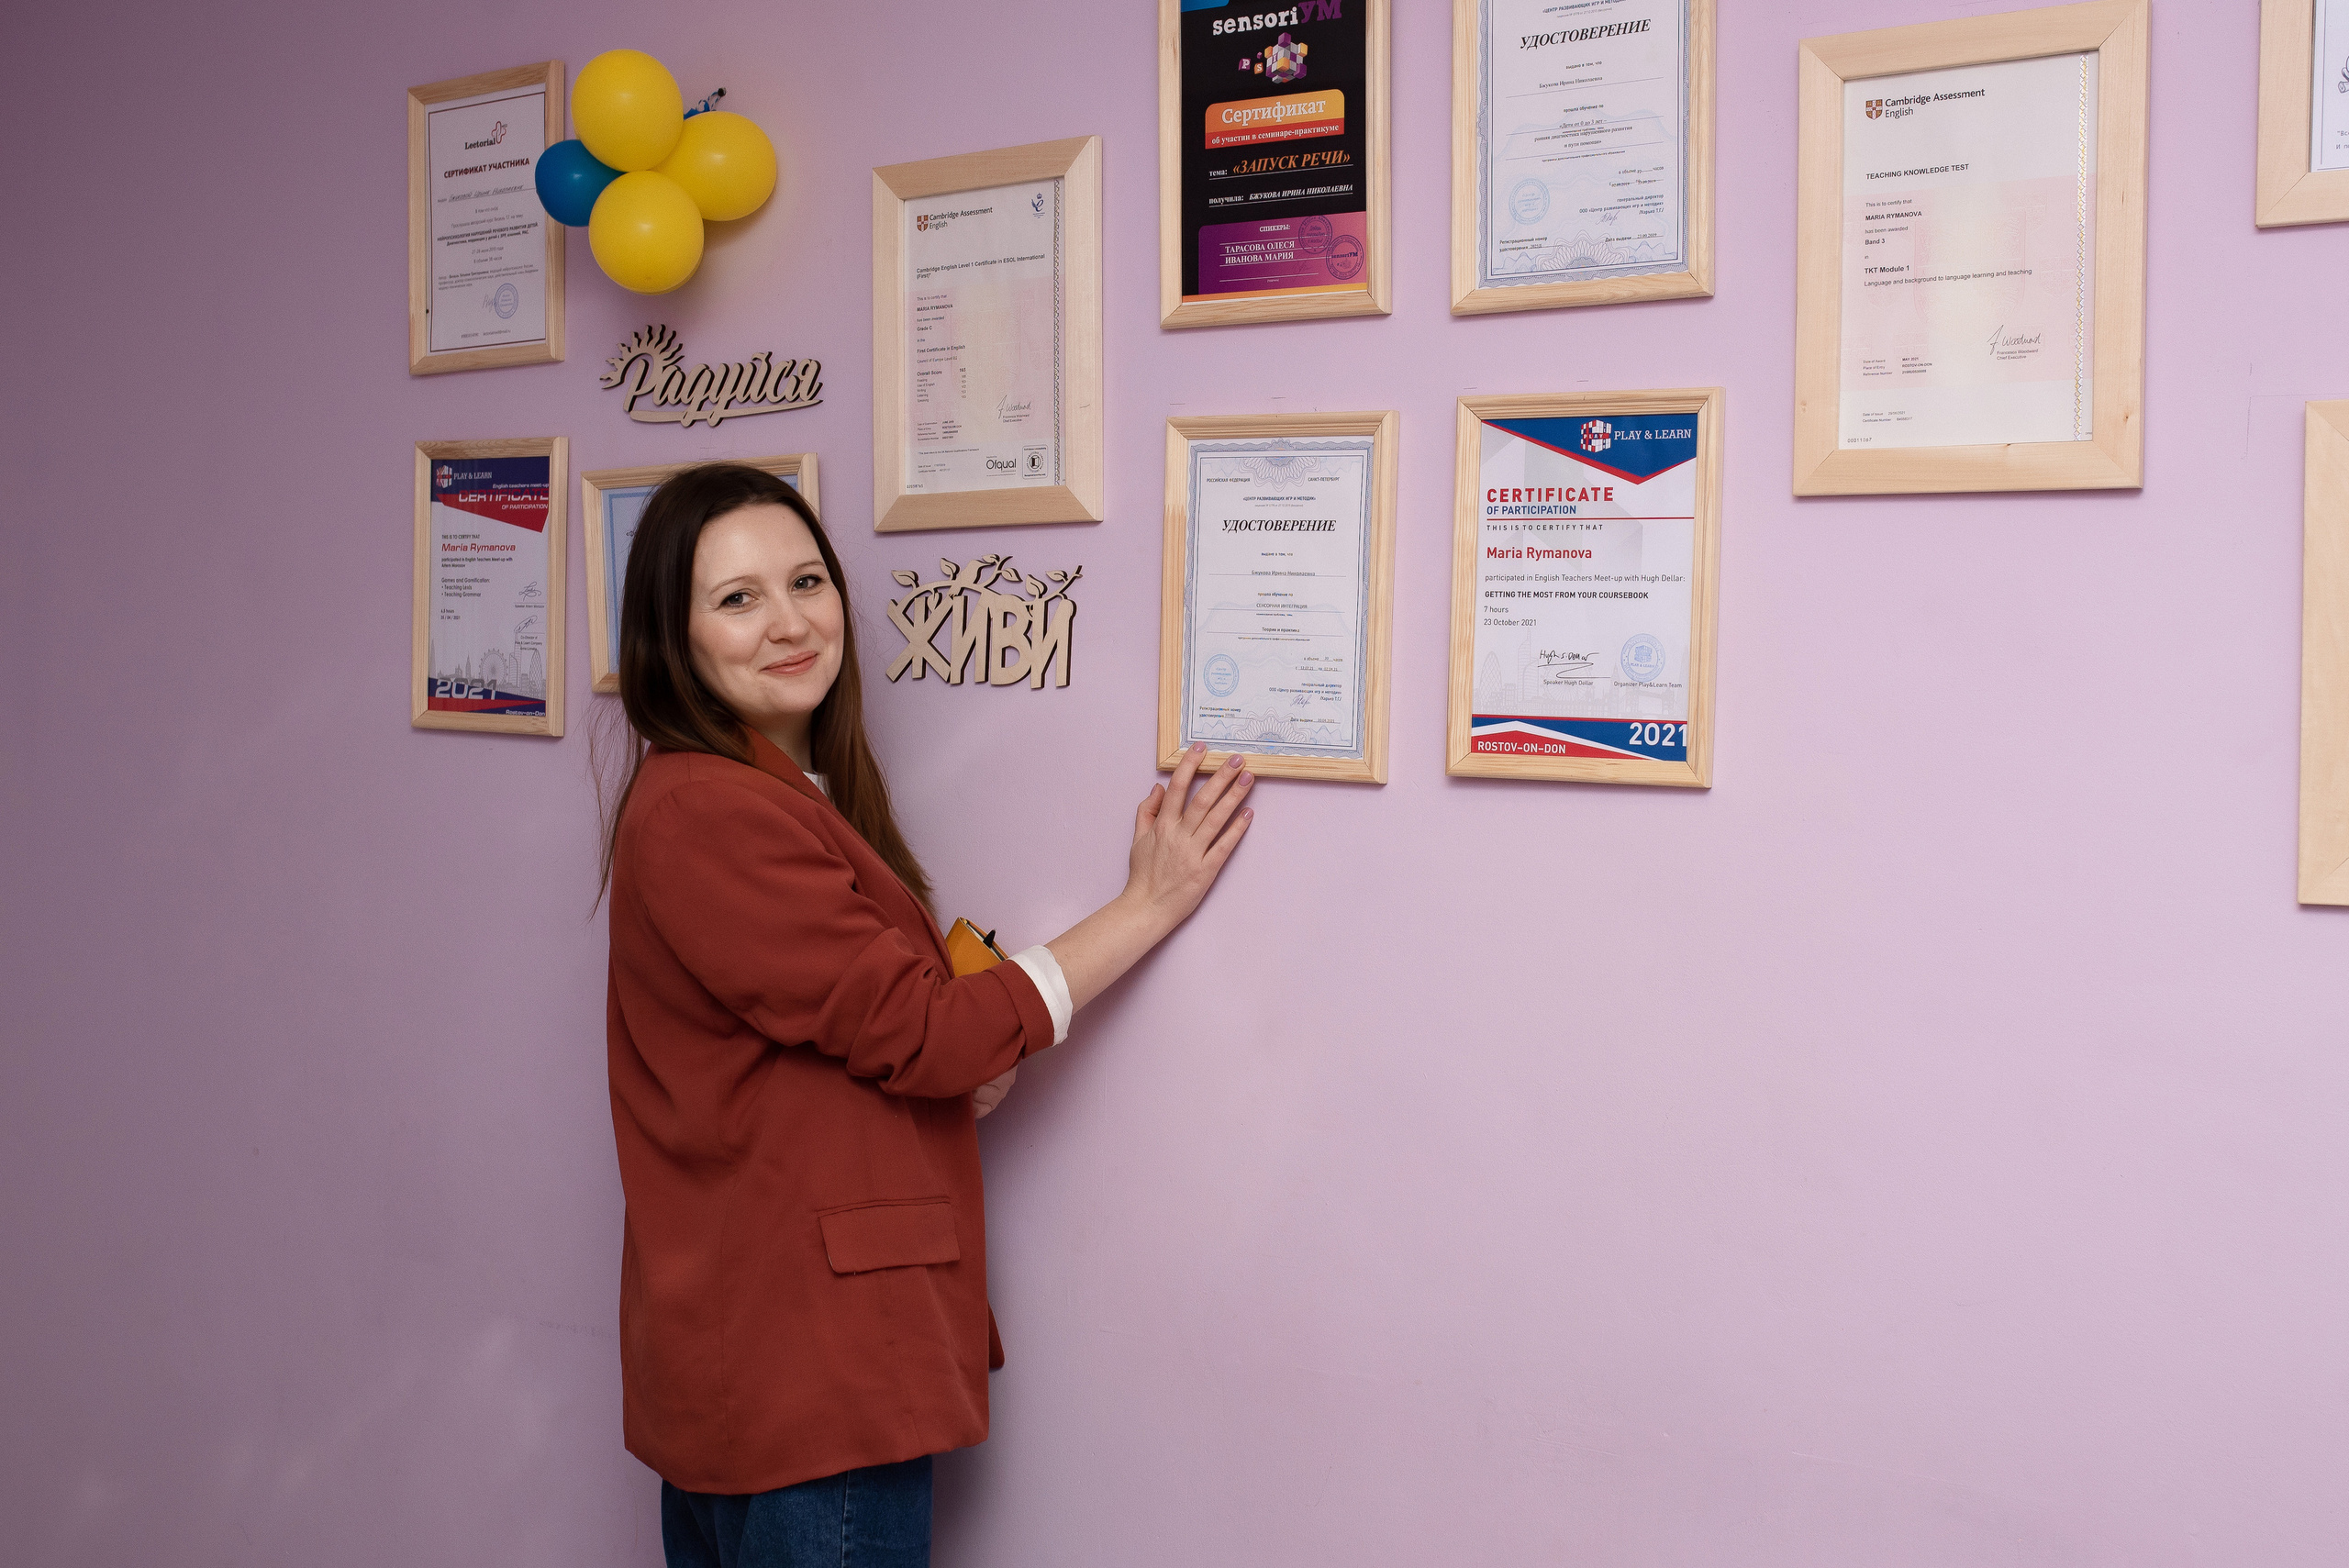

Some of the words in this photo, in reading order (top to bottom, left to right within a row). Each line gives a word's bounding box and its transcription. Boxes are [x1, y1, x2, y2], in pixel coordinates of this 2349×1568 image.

[1520, 18, 1651, 50] УДОСТОВЕРЕНИЕ
[1885, 95, 1931, 108] Cambridge
[1933, 88, 1985, 102] Assessment
[1222, 100, 1325, 126] Сертификат
[1885, 106, 1913, 119] English
[1221, 134, 1250, 144] участии
[1258, 125, 1339, 139] семинаре-практикуме
[465, 138, 495, 150] Lectorial
[444, 164, 487, 179] СЕРТИФИКАТ
[488, 158, 529, 172] УЧАСТНИКА
[1209, 169, 1227, 177] тема:
[1233, 155, 1299, 174] «ЗАПУСК
[1302, 150, 1351, 168] РЕЧИ»
[1866, 170, 1902, 180] TEACHING
[1904, 165, 1949, 176] KNOWLEDGE
[1952, 163, 1969, 172] TEST
[1208, 195, 1244, 206] получила:
[1249, 191, 1281, 200] БЖУКОВА
[1282, 189, 1305, 197] ИРИНА
[1307, 184, 1353, 195] НИКОЛАЕВНА
[930, 212, 959, 221] Cambridge
[961, 206, 993, 217] Assessment
[1887, 211, 1922, 220] RYMANOVA
[930, 220, 948, 230] English
[1225, 243, 1265, 253] ТАРАСОВА
[1267, 241, 1295, 250] ОЛЕСЯ
[974, 259, 996, 267] Certificate
[1017, 253, 1045, 261] International
[1225, 254, 1264, 264] ИВАНОВА
[1264, 252, 1294, 261] МАРИЯ
[1880, 265, 1904, 273] Module
[1905, 275, 1937, 284] background
[1945, 273, 1971, 283] language
[1972, 271, 1995, 280] learning
[2007, 269, 2032, 277] teaching
[1614, 430, 1642, 440] PLAY
[1644, 430, 1653, 439] &
[1654, 428, 1691, 439] LEARN
[986, 459, 1017, 471] Ofqual
[459, 488, 549, 503] CERTIFICATE
[1487, 486, 1613, 503] CERTIFICATE
[1486, 506, 1499, 515] OF
[1502, 506, 1576, 515] PARTICIPATION
[1222, 519, 1336, 533] УДОСТОВЕРЕНИЕ
[441, 543, 468, 551] Maria
[470, 543, 516, 553] Rymanova
[1486, 547, 1522, 559] Maria
[1527, 547, 1592, 562] Rymanova
[1485, 574, 1525, 583] participated
[1534, 574, 1559, 584] English
[1594, 575, 1622, 584] Meet-up
[1641, 575, 1659, 584] Hugh
[1555, 591, 1575, 599] FROM
[885, 594, 1077, 689] ЖИВИ
[435, 678, 497, 700] 2021
[1629, 722, 1687, 747] 2021
[1477, 740, 1566, 754] ROSTOV-ON-DON
